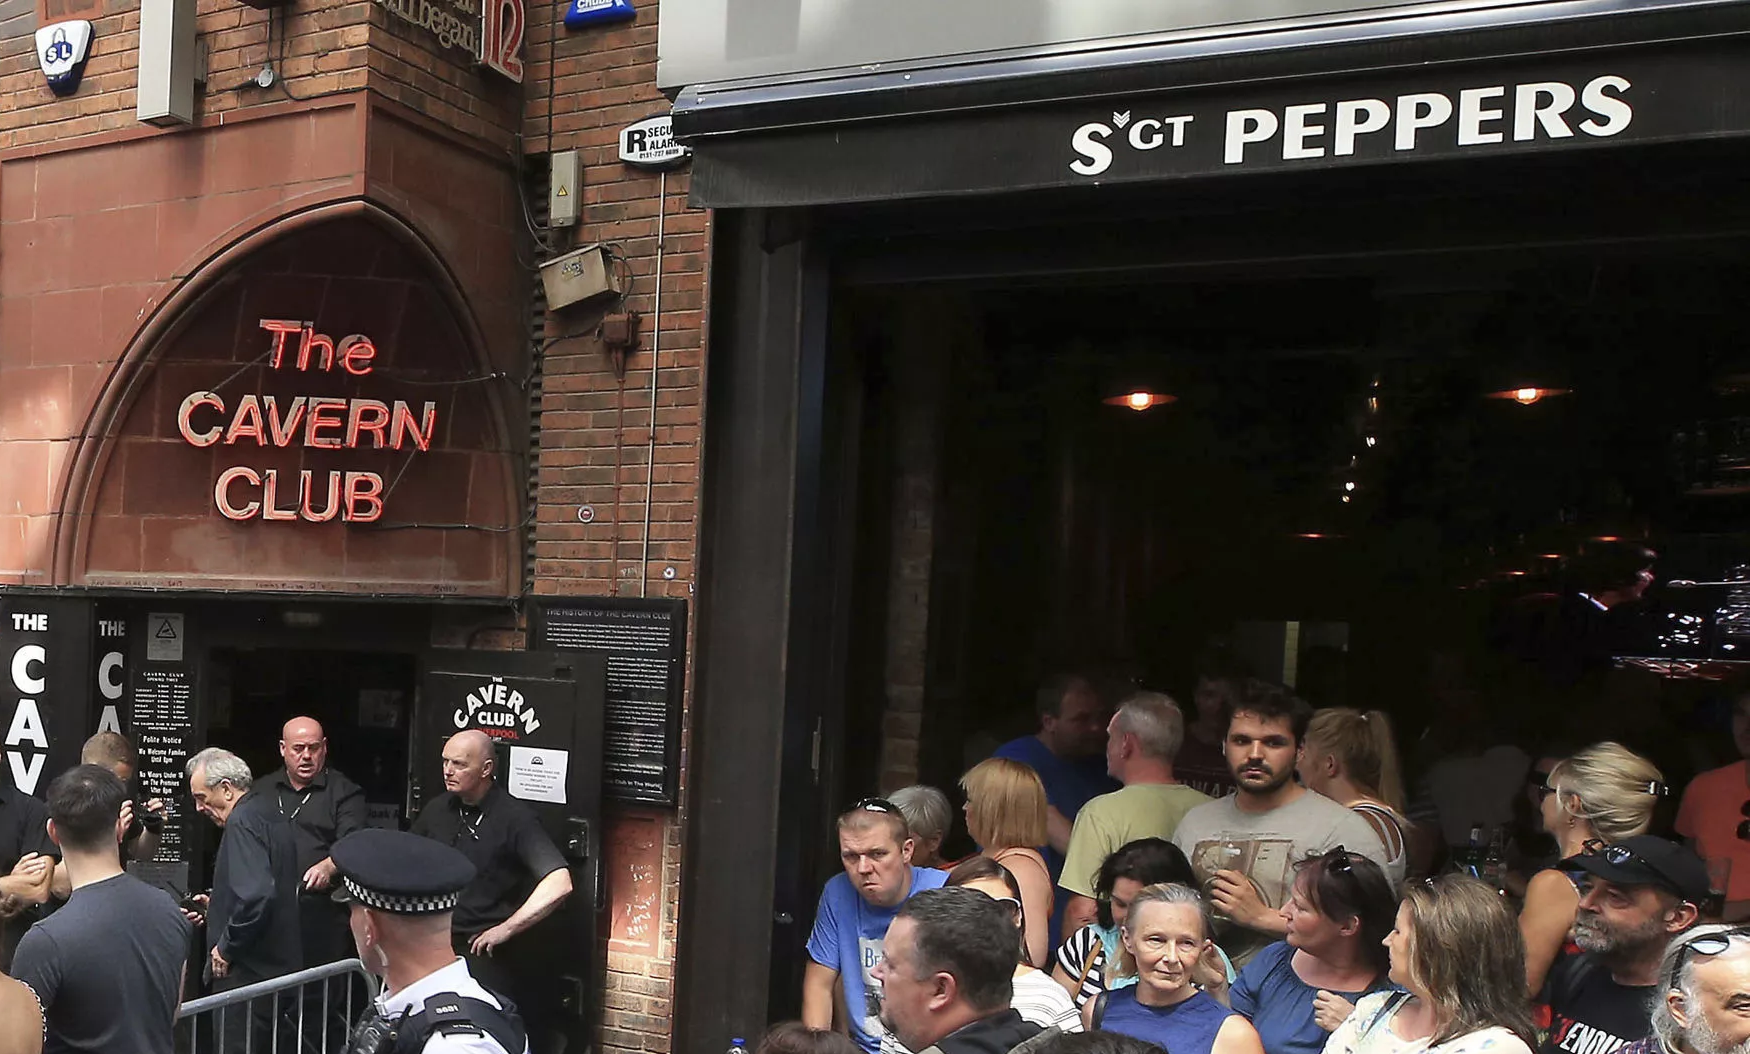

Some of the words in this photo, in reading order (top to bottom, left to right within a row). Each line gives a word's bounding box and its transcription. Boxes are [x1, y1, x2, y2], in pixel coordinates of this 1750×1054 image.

[627, 130, 647, 153] R
[1223, 75, 1633, 164] PEPPERS
[259, 319, 376, 375] The
[178, 391, 436, 451] CAVERN
[215, 466, 383, 522] CLUB
[12, 614, 48, 631] THE
[99, 620, 126, 637] THE
[5, 645, 49, 796] CAV
[453, 683, 541, 735] CAVERN
[477, 711, 515, 727] CLUB
